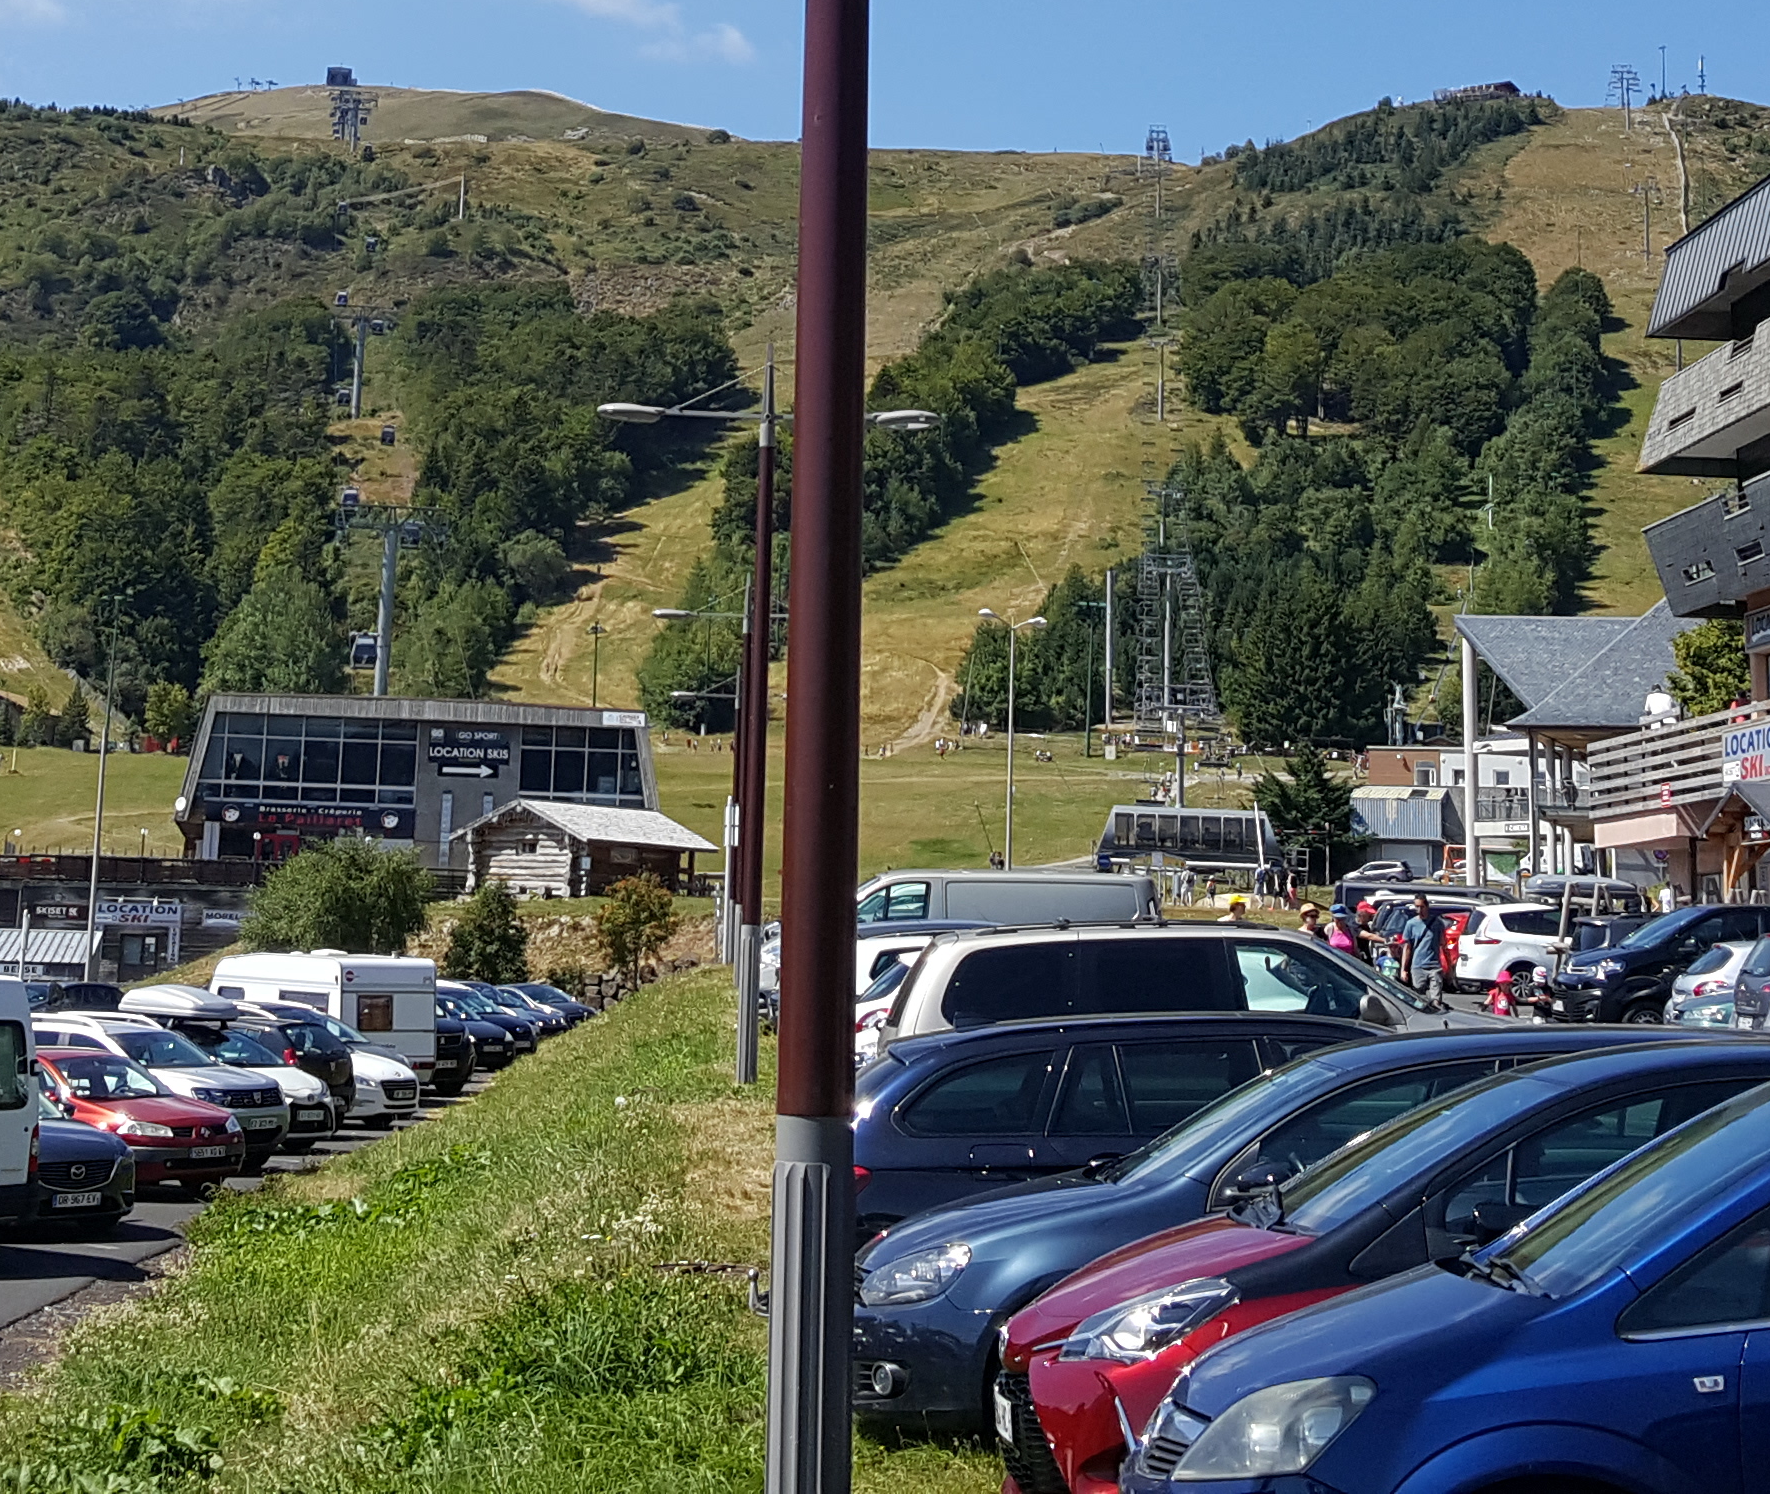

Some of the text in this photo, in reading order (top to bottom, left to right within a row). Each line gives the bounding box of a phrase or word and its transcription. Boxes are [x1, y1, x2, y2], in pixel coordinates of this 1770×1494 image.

[458, 731, 498, 740] GO SPORT
[429, 746, 509, 759] LOCATION SKIS
[1740, 753, 1764, 781] SKI
[259, 805, 308, 815] Brasserie
[35, 906, 67, 915] SKISET
[97, 903, 179, 915] LOCATION
[118, 914, 150, 923] SKI
[3, 965, 38, 974] BESE
